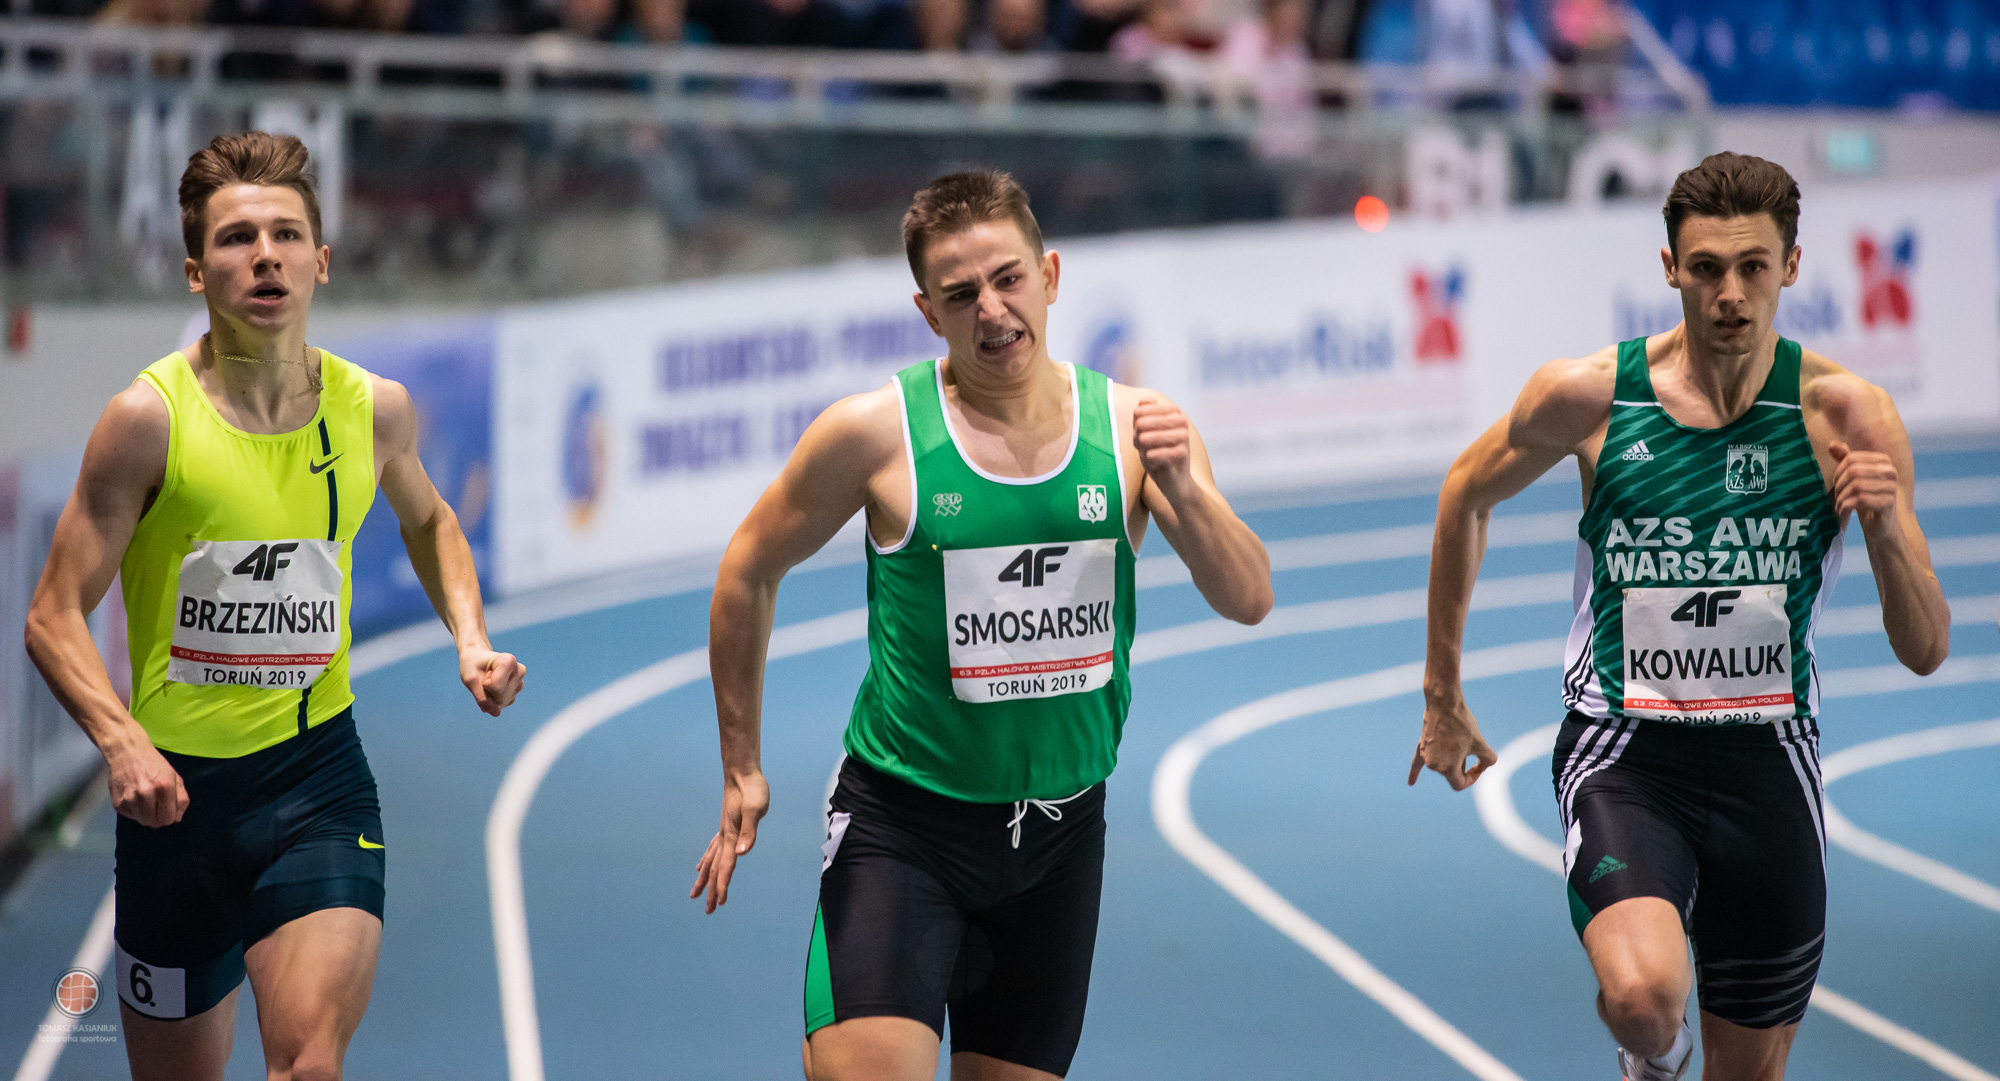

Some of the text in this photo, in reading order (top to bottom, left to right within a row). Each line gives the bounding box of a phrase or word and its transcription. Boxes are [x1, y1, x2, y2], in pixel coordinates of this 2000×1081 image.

[1622, 452, 1654, 461] adidas
[1605, 517, 1811, 548] AZS AWF
[232, 542, 299, 581] 4F
[997, 546, 1069, 588] 4F
[1604, 550, 1801, 582] WARSZAWA
[179, 594, 335, 634] BRZEZIŃSKI
[1670, 590, 1742, 628] 4F
[954, 600, 1110, 646] SMOSARSKI
[193, 653, 215, 661] PZLA
[216, 655, 250, 663] HALOWE
[250, 656, 305, 664] MISTRZOSTWA
[974, 668, 997, 676] PZLA
[998, 665, 1030, 675] HALOWE
[1031, 660, 1085, 671] MISTRZOSTWA
[1630, 643, 1786, 681] KOWALUK
[203, 666, 307, 685] TORUŃ 2019
[987, 673, 1087, 697] TORUŃ 2019
[1702, 699, 1758, 708] MISTRZOSTWA
[1758, 696, 1785, 704] POLSKI
[1723, 712, 1762, 725] 2019
[1589, 862, 1628, 883] adidas
